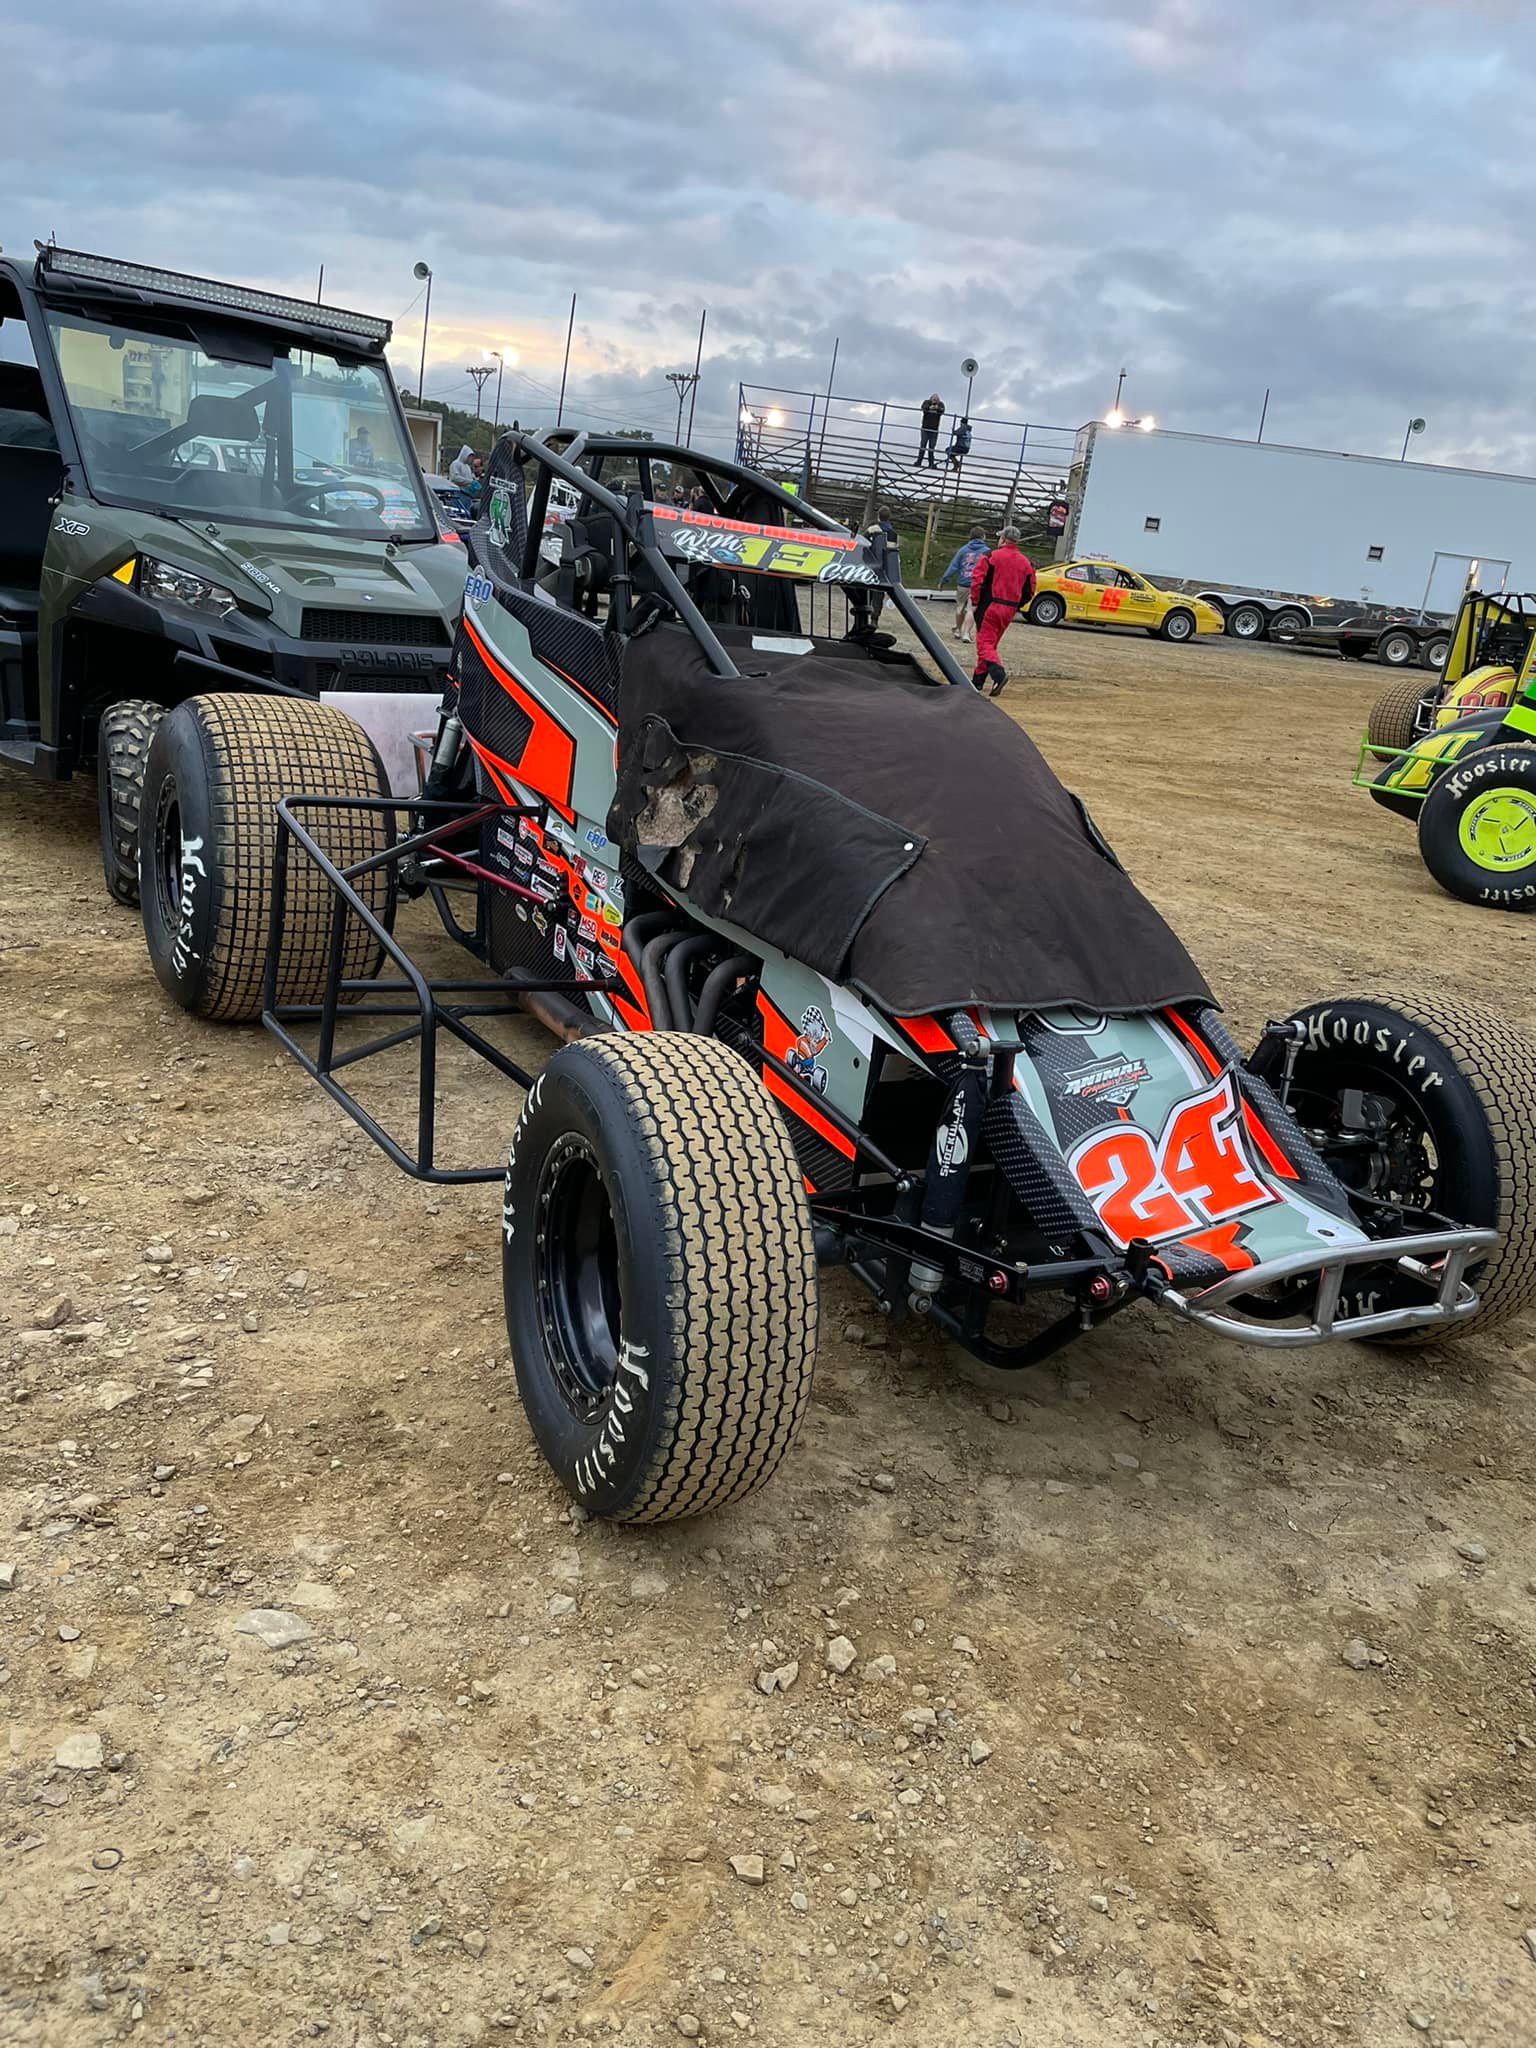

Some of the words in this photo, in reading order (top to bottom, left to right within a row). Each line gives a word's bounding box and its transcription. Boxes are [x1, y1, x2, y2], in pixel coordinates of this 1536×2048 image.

[54, 517, 90, 535] XP
[735, 537, 836, 577] 13
[465, 575, 493, 602] ERO
[340, 650, 434, 670] POLARIS
[1445, 753, 1531, 800] Hoosier
[586, 830, 608, 848] ERO
[172, 828, 207, 980] Hoosier
[581, 916, 597, 933] MSD
[1307, 1009, 1444, 1092] Hoosier
[1063, 1061, 1143, 1096] ANIMAL
[1070, 1078, 1271, 1246] 24
[578, 1335, 650, 1495] Hoosier
